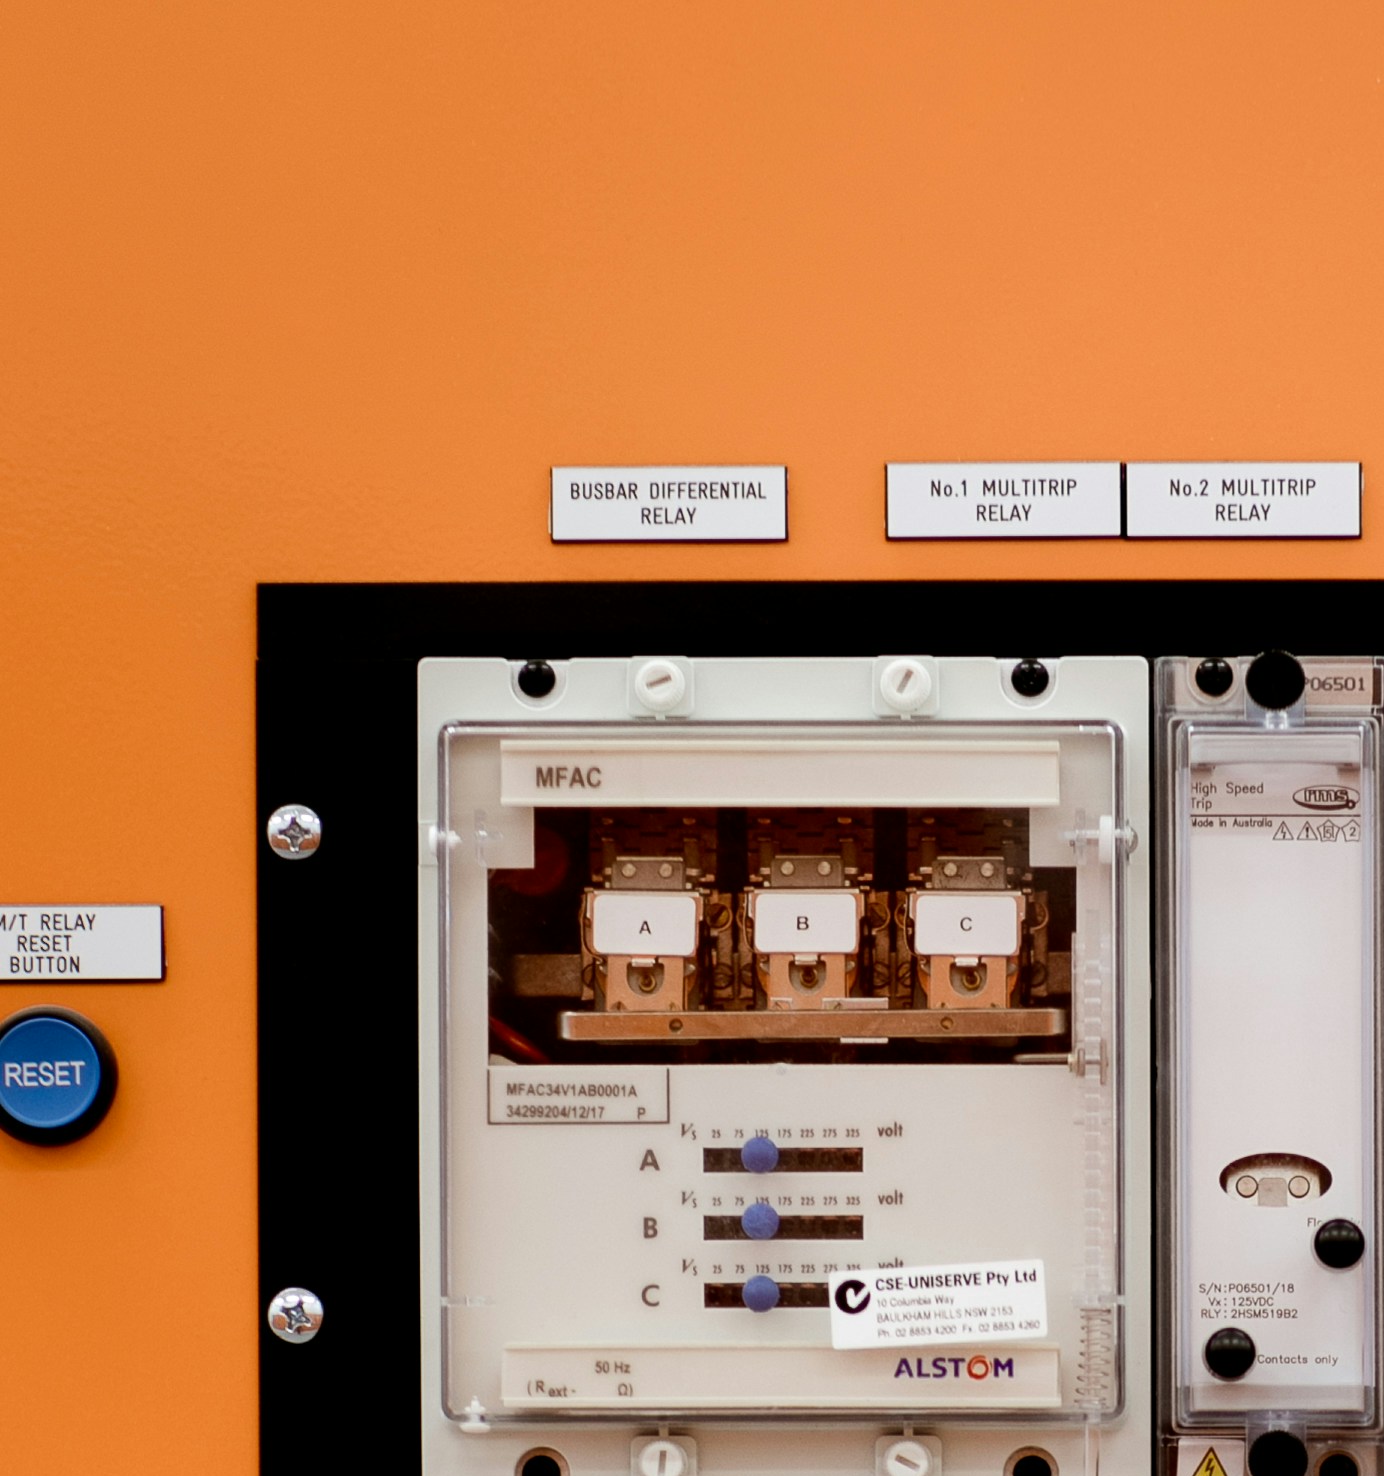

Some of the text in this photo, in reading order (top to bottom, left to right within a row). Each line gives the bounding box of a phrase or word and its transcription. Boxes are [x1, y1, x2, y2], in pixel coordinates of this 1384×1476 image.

[570, 481, 767, 500] BUSBAR DIFFERENTIAL
[930, 478, 1077, 497] No.1 MULTITRIP
[1169, 478, 1317, 497] No.2 MULTITRIP
[641, 507, 697, 525] RELAY
[976, 504, 1032, 522] RELAY
[1215, 503, 1271, 522] RELAY
[535, 766, 602, 789] MFAC
[1191, 782, 1264, 797] High Speed
[1191, 797, 1213, 811] Trip
[1232, 817, 1273, 828] Australia
[40, 913, 96, 932] RELAY
[639, 920, 652, 935] A
[796, 916, 810, 931] B
[959, 916, 973, 932] C
[17, 934, 72, 953] RESET
[9, 955, 80, 974] BUTTON
[4, 1060, 86, 1087] RESET
[711, 1128, 721, 1139] 25
[734, 1128, 744, 1139] 75
[777, 1128, 792, 1138] 175
[800, 1128, 815, 1138] 225
[822, 1128, 837, 1138] 275
[845, 1128, 861, 1138] 325
[877, 1121, 903, 1138] volt
[639, 1148, 661, 1172] A
[643, 1216, 658, 1240] B
[875, 1269, 1037, 1292] CSE-UNISERVE Pty Ltd
[641, 1283, 660, 1308] C
[1232, 1297, 1274, 1307] 125VDC
[964, 1307, 987, 1318] NSW
[594, 1360, 631, 1375] 50 Hz
[894, 1354, 1014, 1380] ALSTOM
[1257, 1354, 1339, 1367] Contacts only
